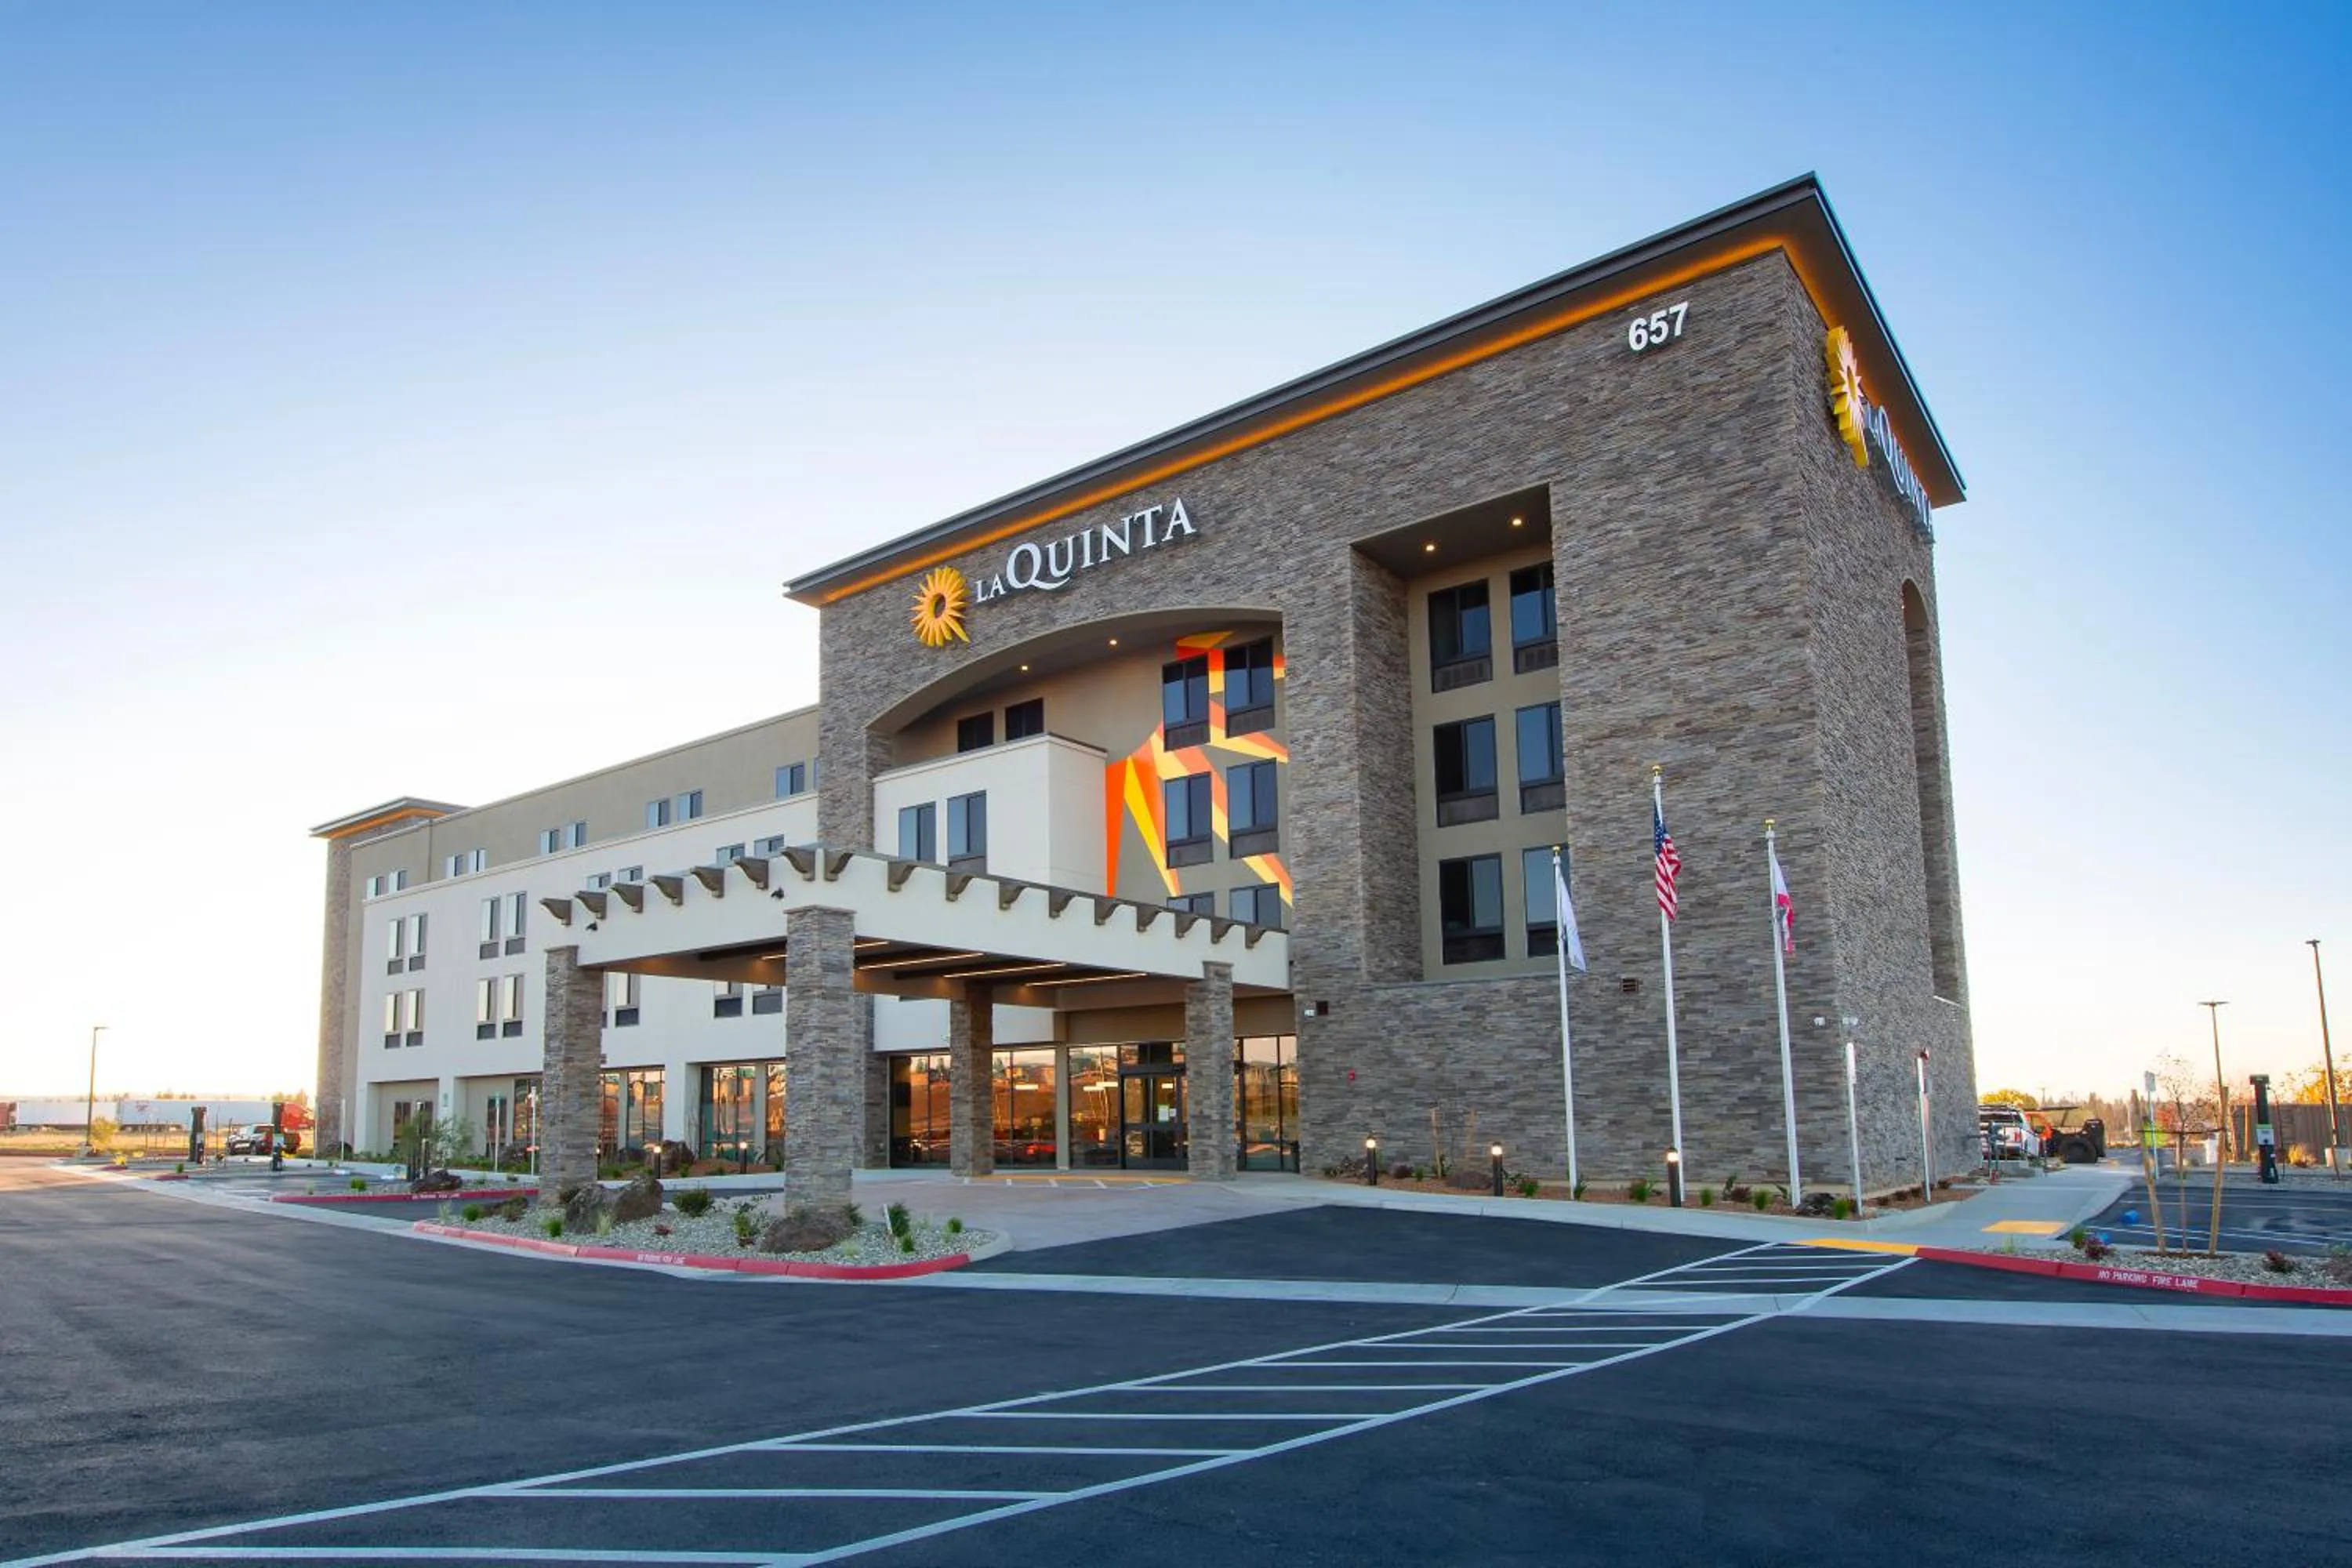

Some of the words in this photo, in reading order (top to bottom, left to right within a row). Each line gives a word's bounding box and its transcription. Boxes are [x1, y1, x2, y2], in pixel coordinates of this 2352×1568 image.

[1628, 301, 1689, 350] 657
[975, 573, 1007, 603] LA
[1006, 496, 1197, 590] QUINTA
[2098, 1270, 2110, 1279] NO
[2112, 1271, 2147, 1283] PARKING
[2152, 1276, 2172, 1286] FIRE
[2176, 1278, 2198, 1288] LANE
